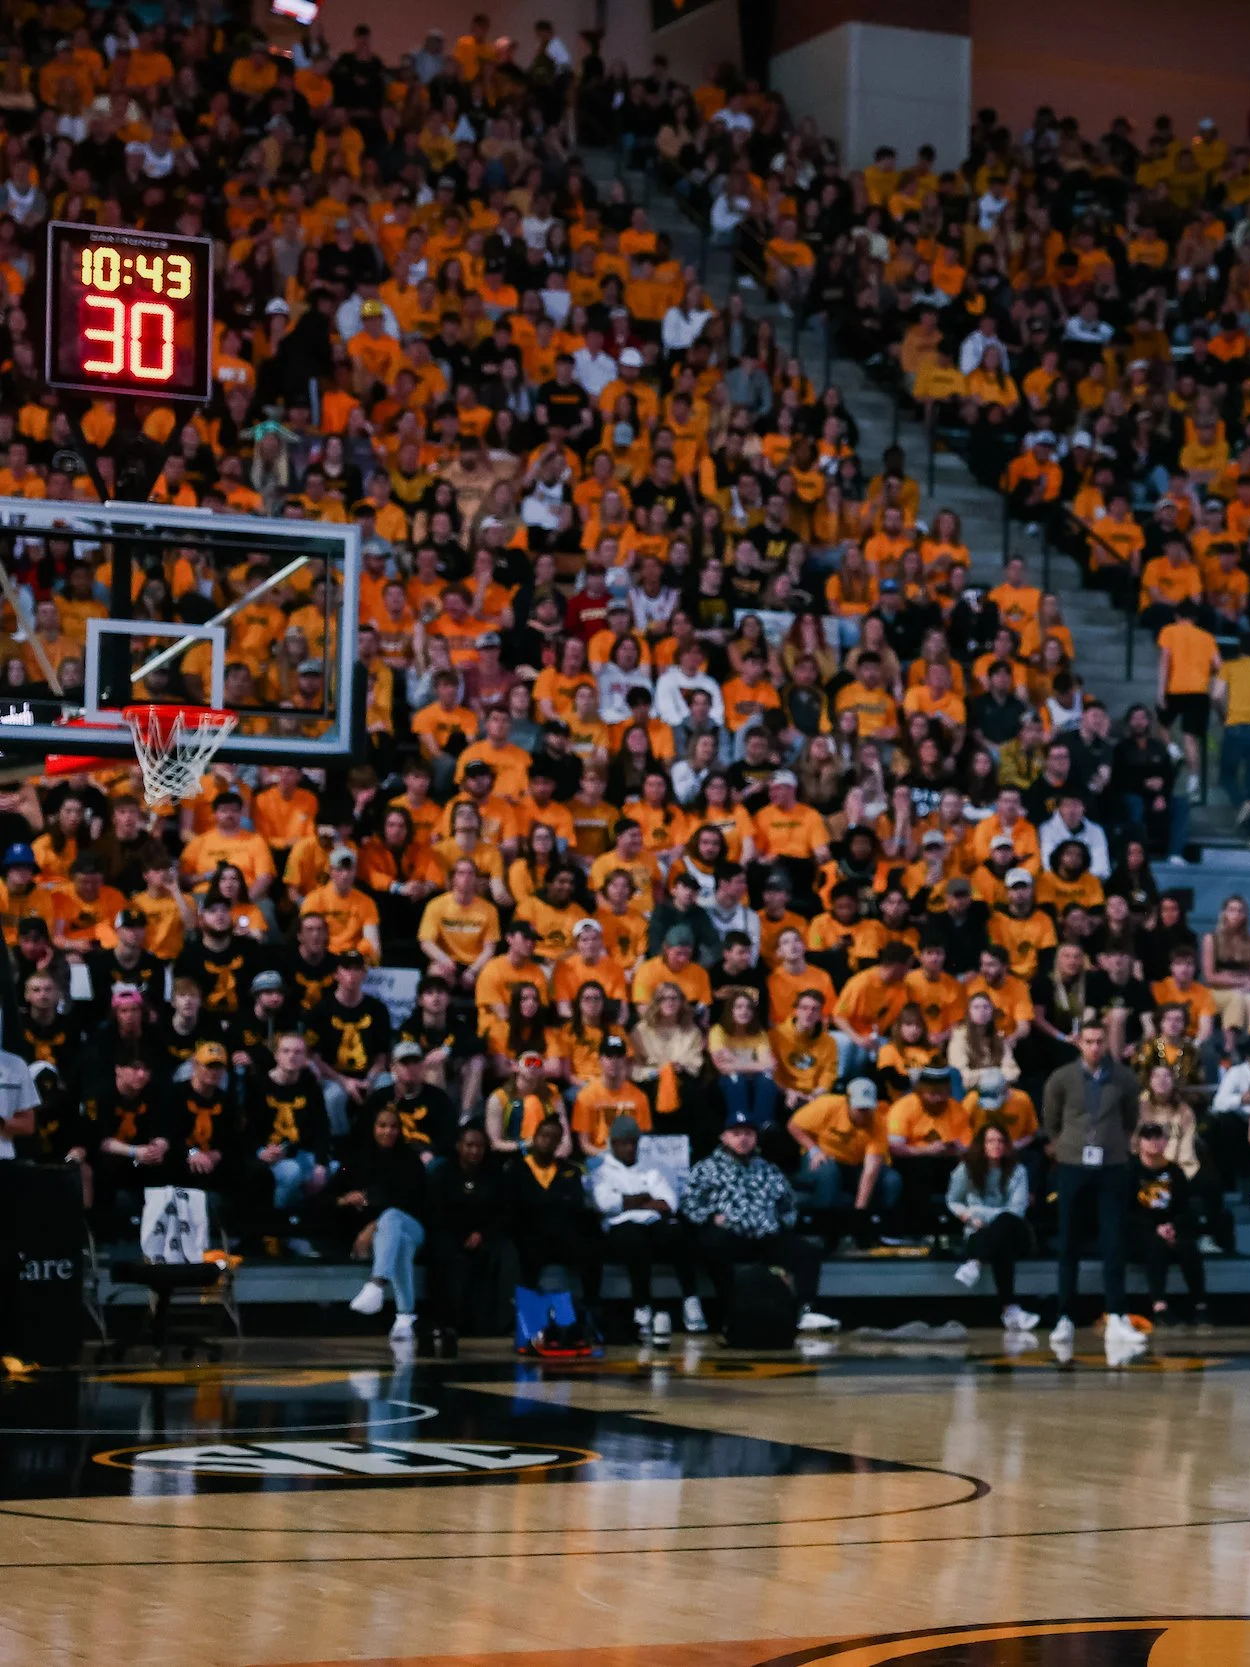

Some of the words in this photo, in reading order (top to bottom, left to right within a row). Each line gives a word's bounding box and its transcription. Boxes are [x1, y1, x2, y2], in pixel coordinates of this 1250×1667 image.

[82, 247, 192, 299] 10:43
[84, 295, 174, 379] 30
[135, 1441, 560, 1475] SEC
